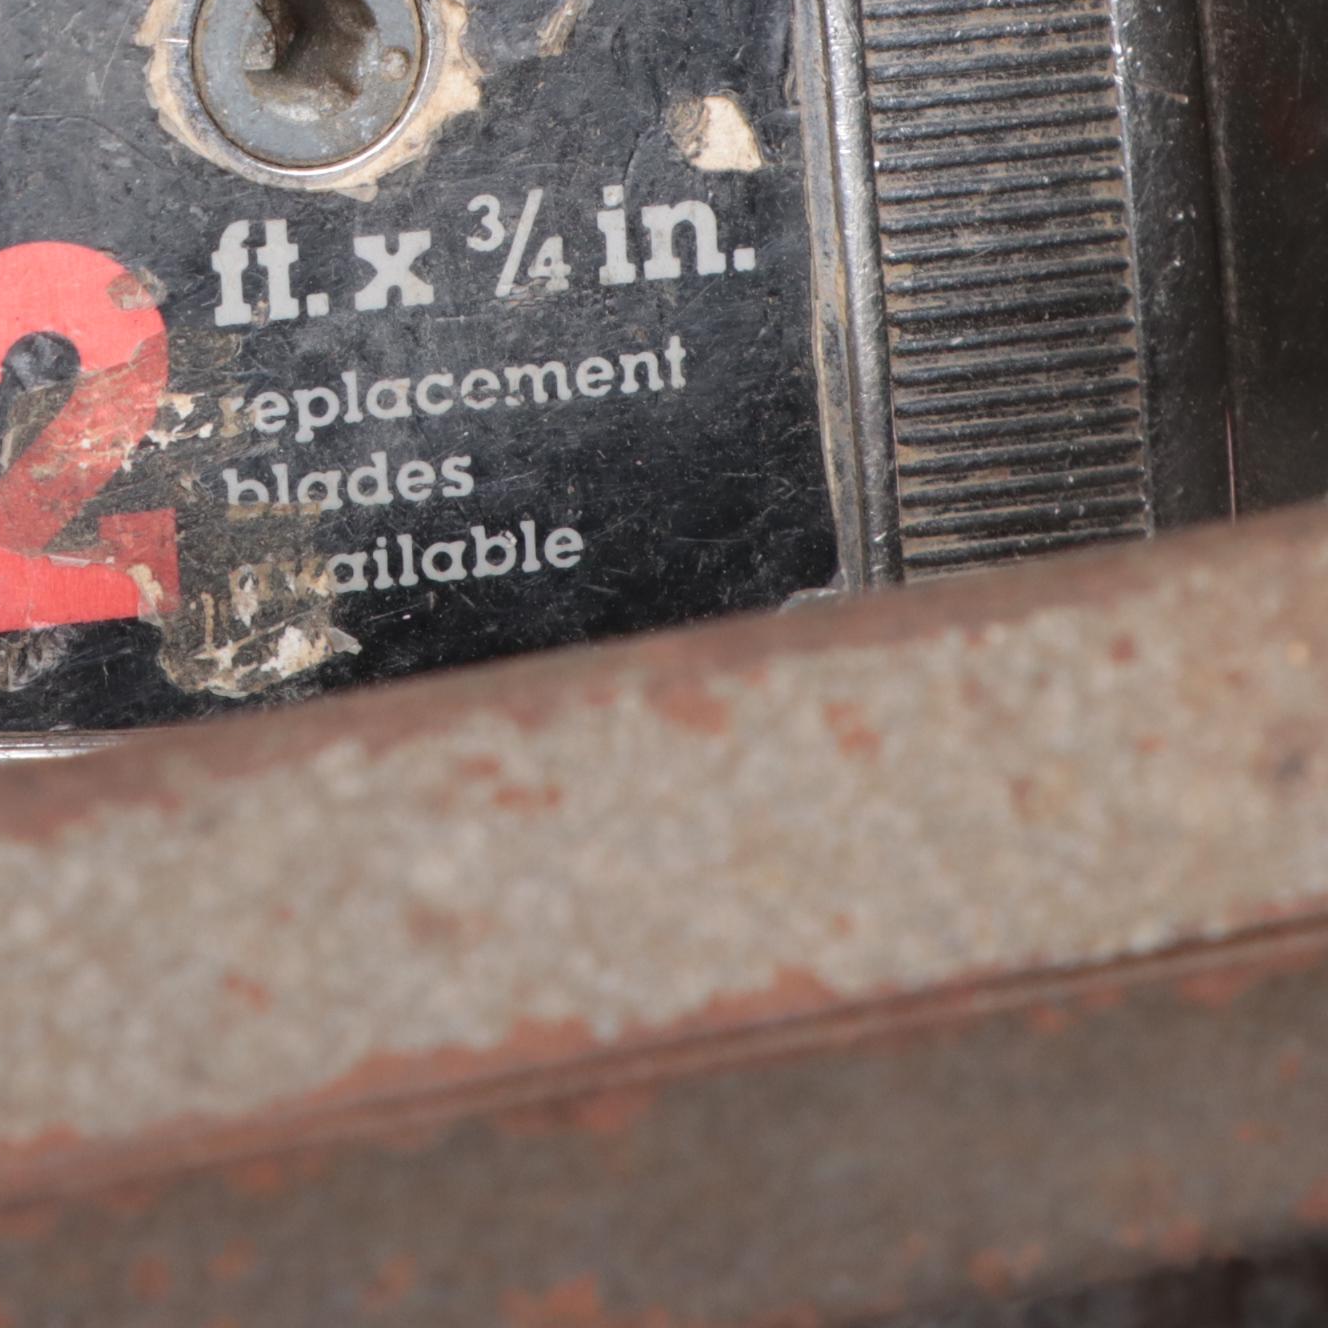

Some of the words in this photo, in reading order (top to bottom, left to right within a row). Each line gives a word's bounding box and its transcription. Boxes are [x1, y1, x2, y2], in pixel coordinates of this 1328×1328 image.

[210, 218, 330, 327] ft.
[353, 230, 434, 310] x
[597, 185, 757, 285] in.
[222, 452, 474, 520] blades
